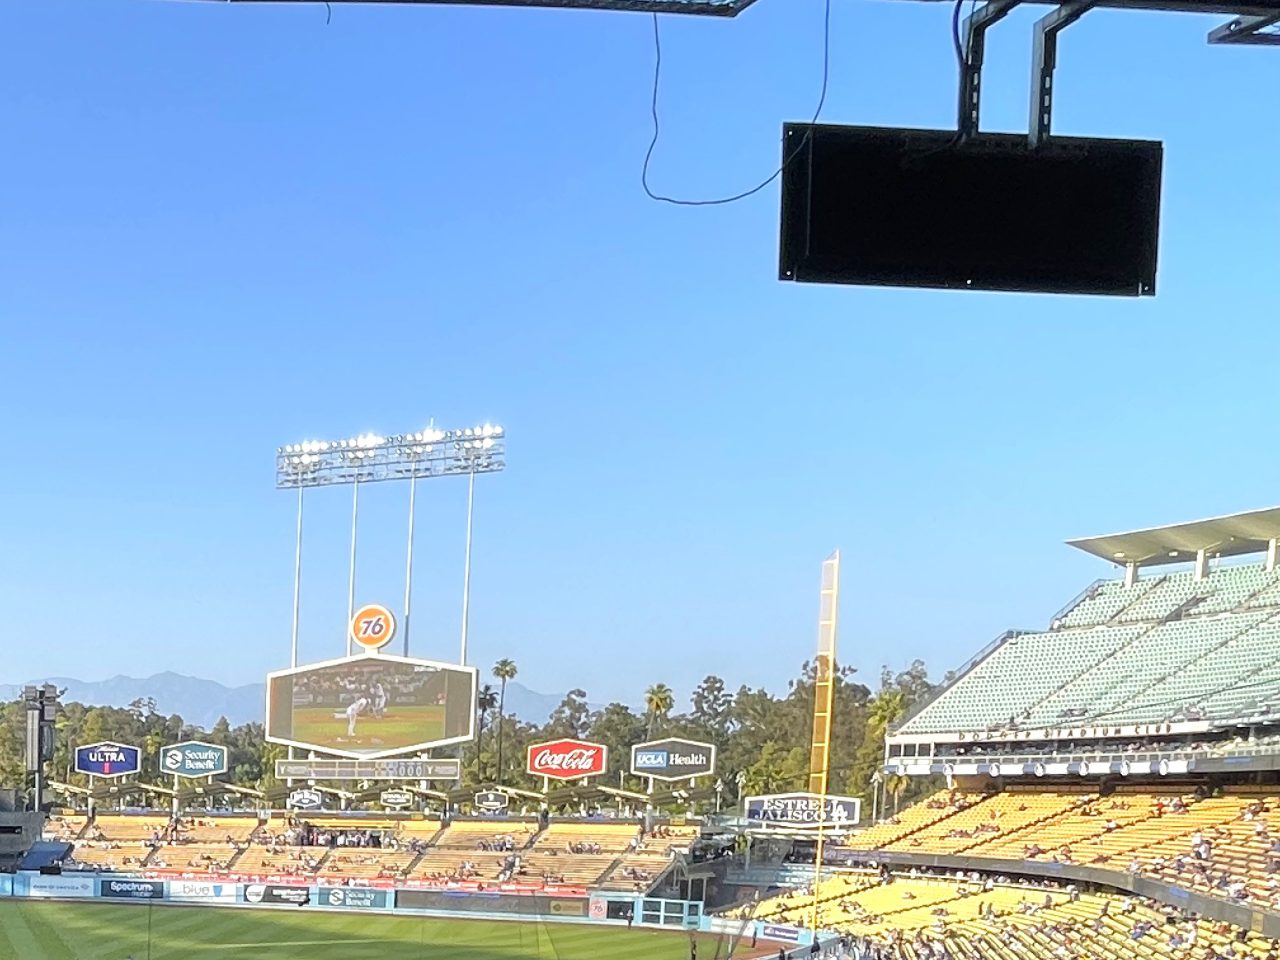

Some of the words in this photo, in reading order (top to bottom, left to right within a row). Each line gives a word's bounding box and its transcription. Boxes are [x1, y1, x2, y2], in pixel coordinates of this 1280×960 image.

[361, 617, 384, 636] 76
[1044, 726, 1121, 738] STADIUM
[89, 753, 126, 762] ULTRA
[184, 750, 221, 761] Security
[636, 753, 664, 765] UCLA
[669, 753, 707, 766] Health
[185, 759, 215, 769] Benefit
[110, 881, 153, 892] Spectrum
